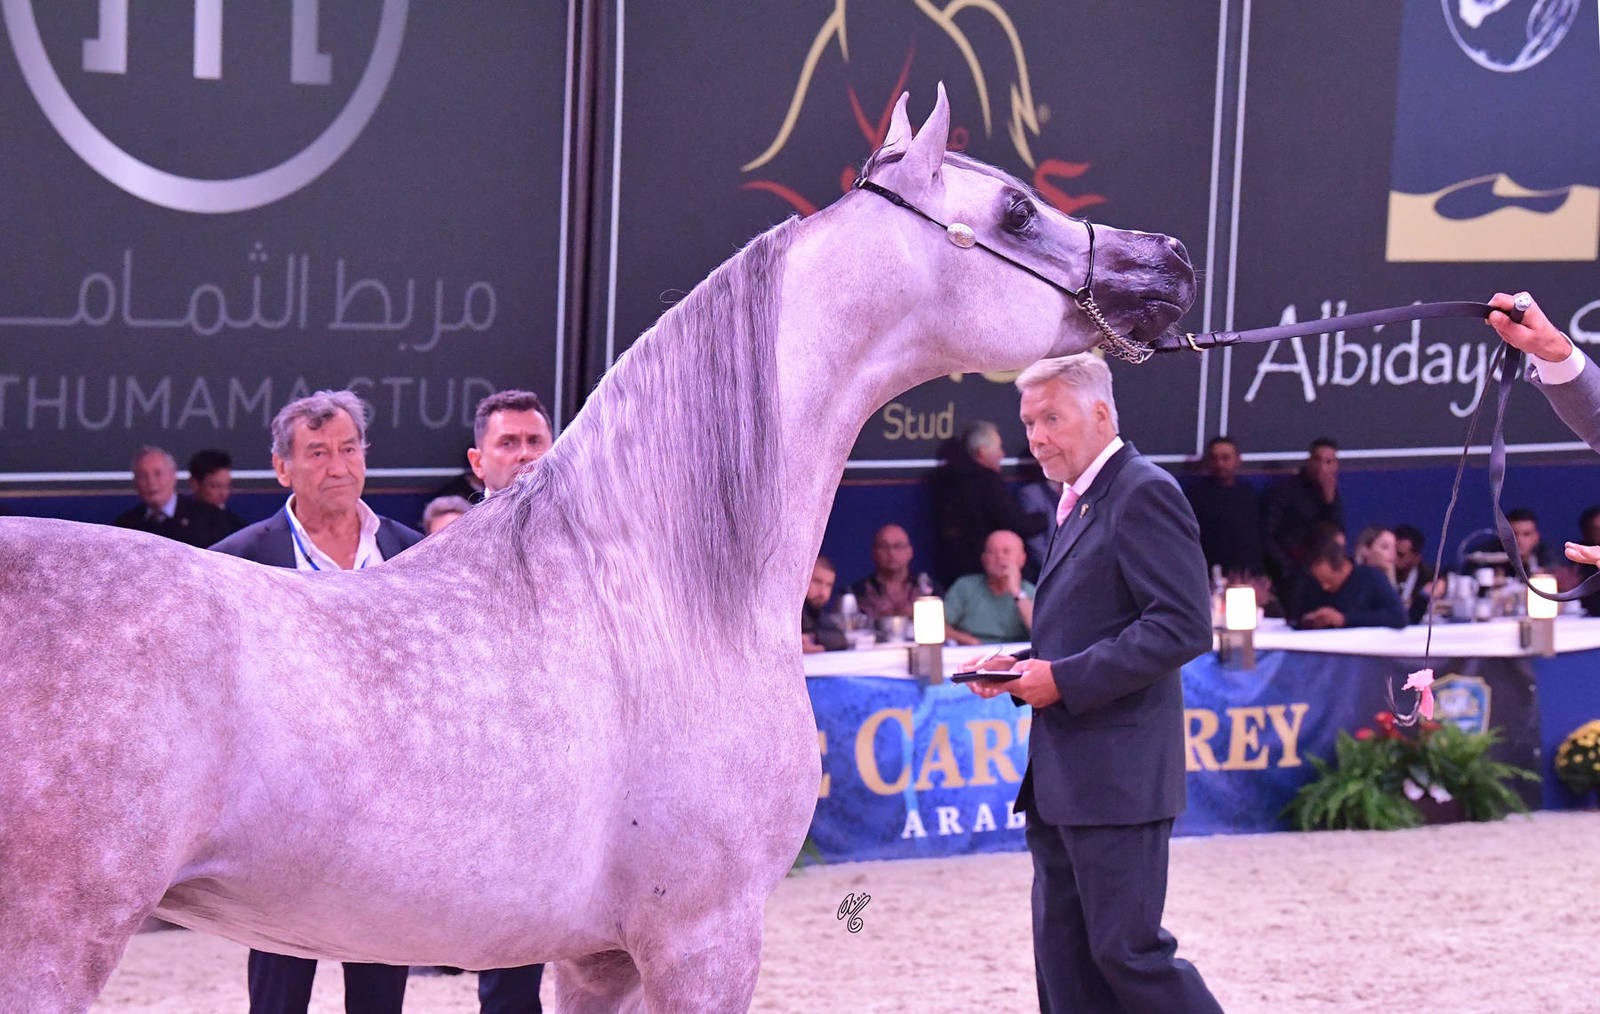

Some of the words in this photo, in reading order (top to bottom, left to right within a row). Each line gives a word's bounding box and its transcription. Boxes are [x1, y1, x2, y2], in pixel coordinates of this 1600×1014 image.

[0, 241, 310, 335] الثمام
[328, 258, 497, 351] مربط
[1245, 300, 1532, 418] Albiday
[882, 402, 955, 440] Stud
